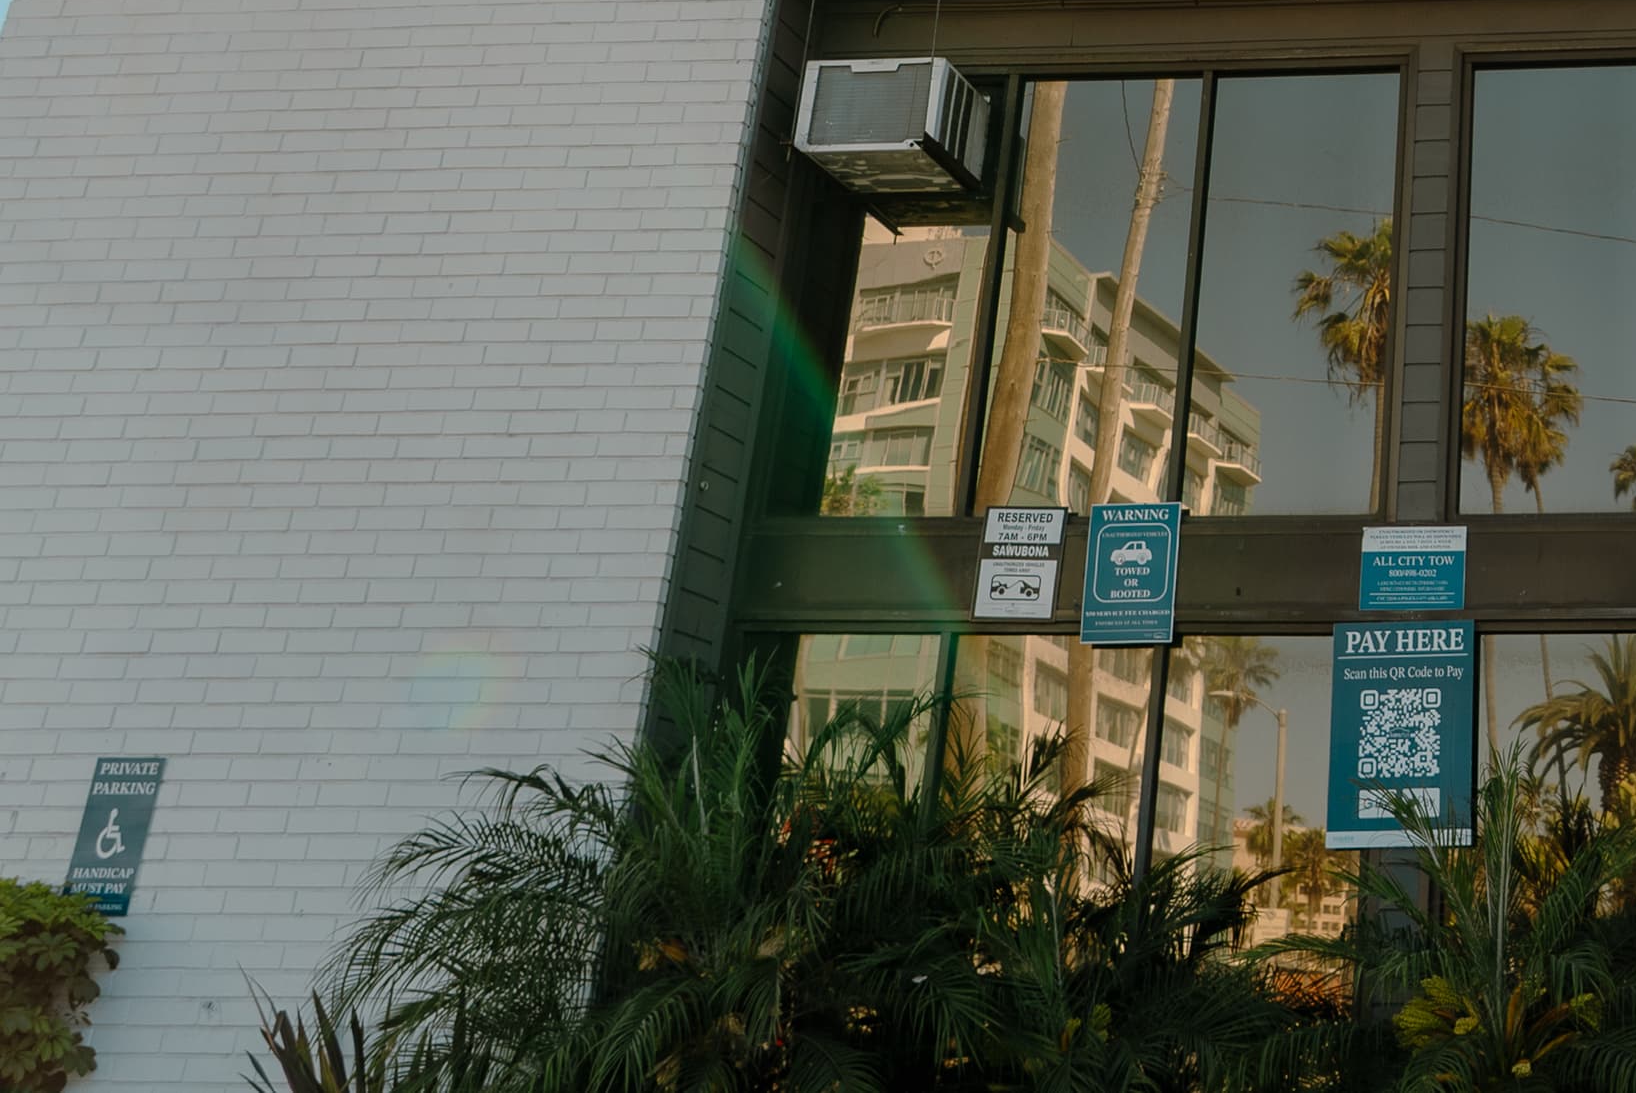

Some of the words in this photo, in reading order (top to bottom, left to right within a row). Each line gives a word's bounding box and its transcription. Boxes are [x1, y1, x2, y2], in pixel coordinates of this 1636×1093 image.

[997, 512, 1054, 523] RESERVED
[1102, 509, 1169, 521] WARNING
[999, 533, 1018, 541] 7AM
[1027, 533, 1047, 541] 6PM
[992, 545, 1049, 557] SAWUBONA
[1373, 556, 1395, 566] ALL
[1398, 556, 1425, 566] CITY
[1428, 555, 1455, 566] TOW
[1114, 567, 1150, 576] TOWED
[1123, 578, 1139, 587] OR
[1110, 589, 1150, 599] BOOTED
[1345, 630, 1391, 653] PAY
[1395, 628, 1464, 652] HERE
[1344, 668, 1367, 680] Scan
[1369, 667, 1387, 679] this
[1389, 666, 1406, 681] QR
[1407, 666, 1432, 678] Code
[1434, 667, 1444, 677] to
[1446, 665, 1463, 680] Pay
[100, 762, 160, 775] PRIVATE
[92, 782, 156, 795] PARKING
[72, 867, 135, 879] HANDICAP
[70, 882, 104, 894] MUST
[104, 882, 127, 894] PAY
